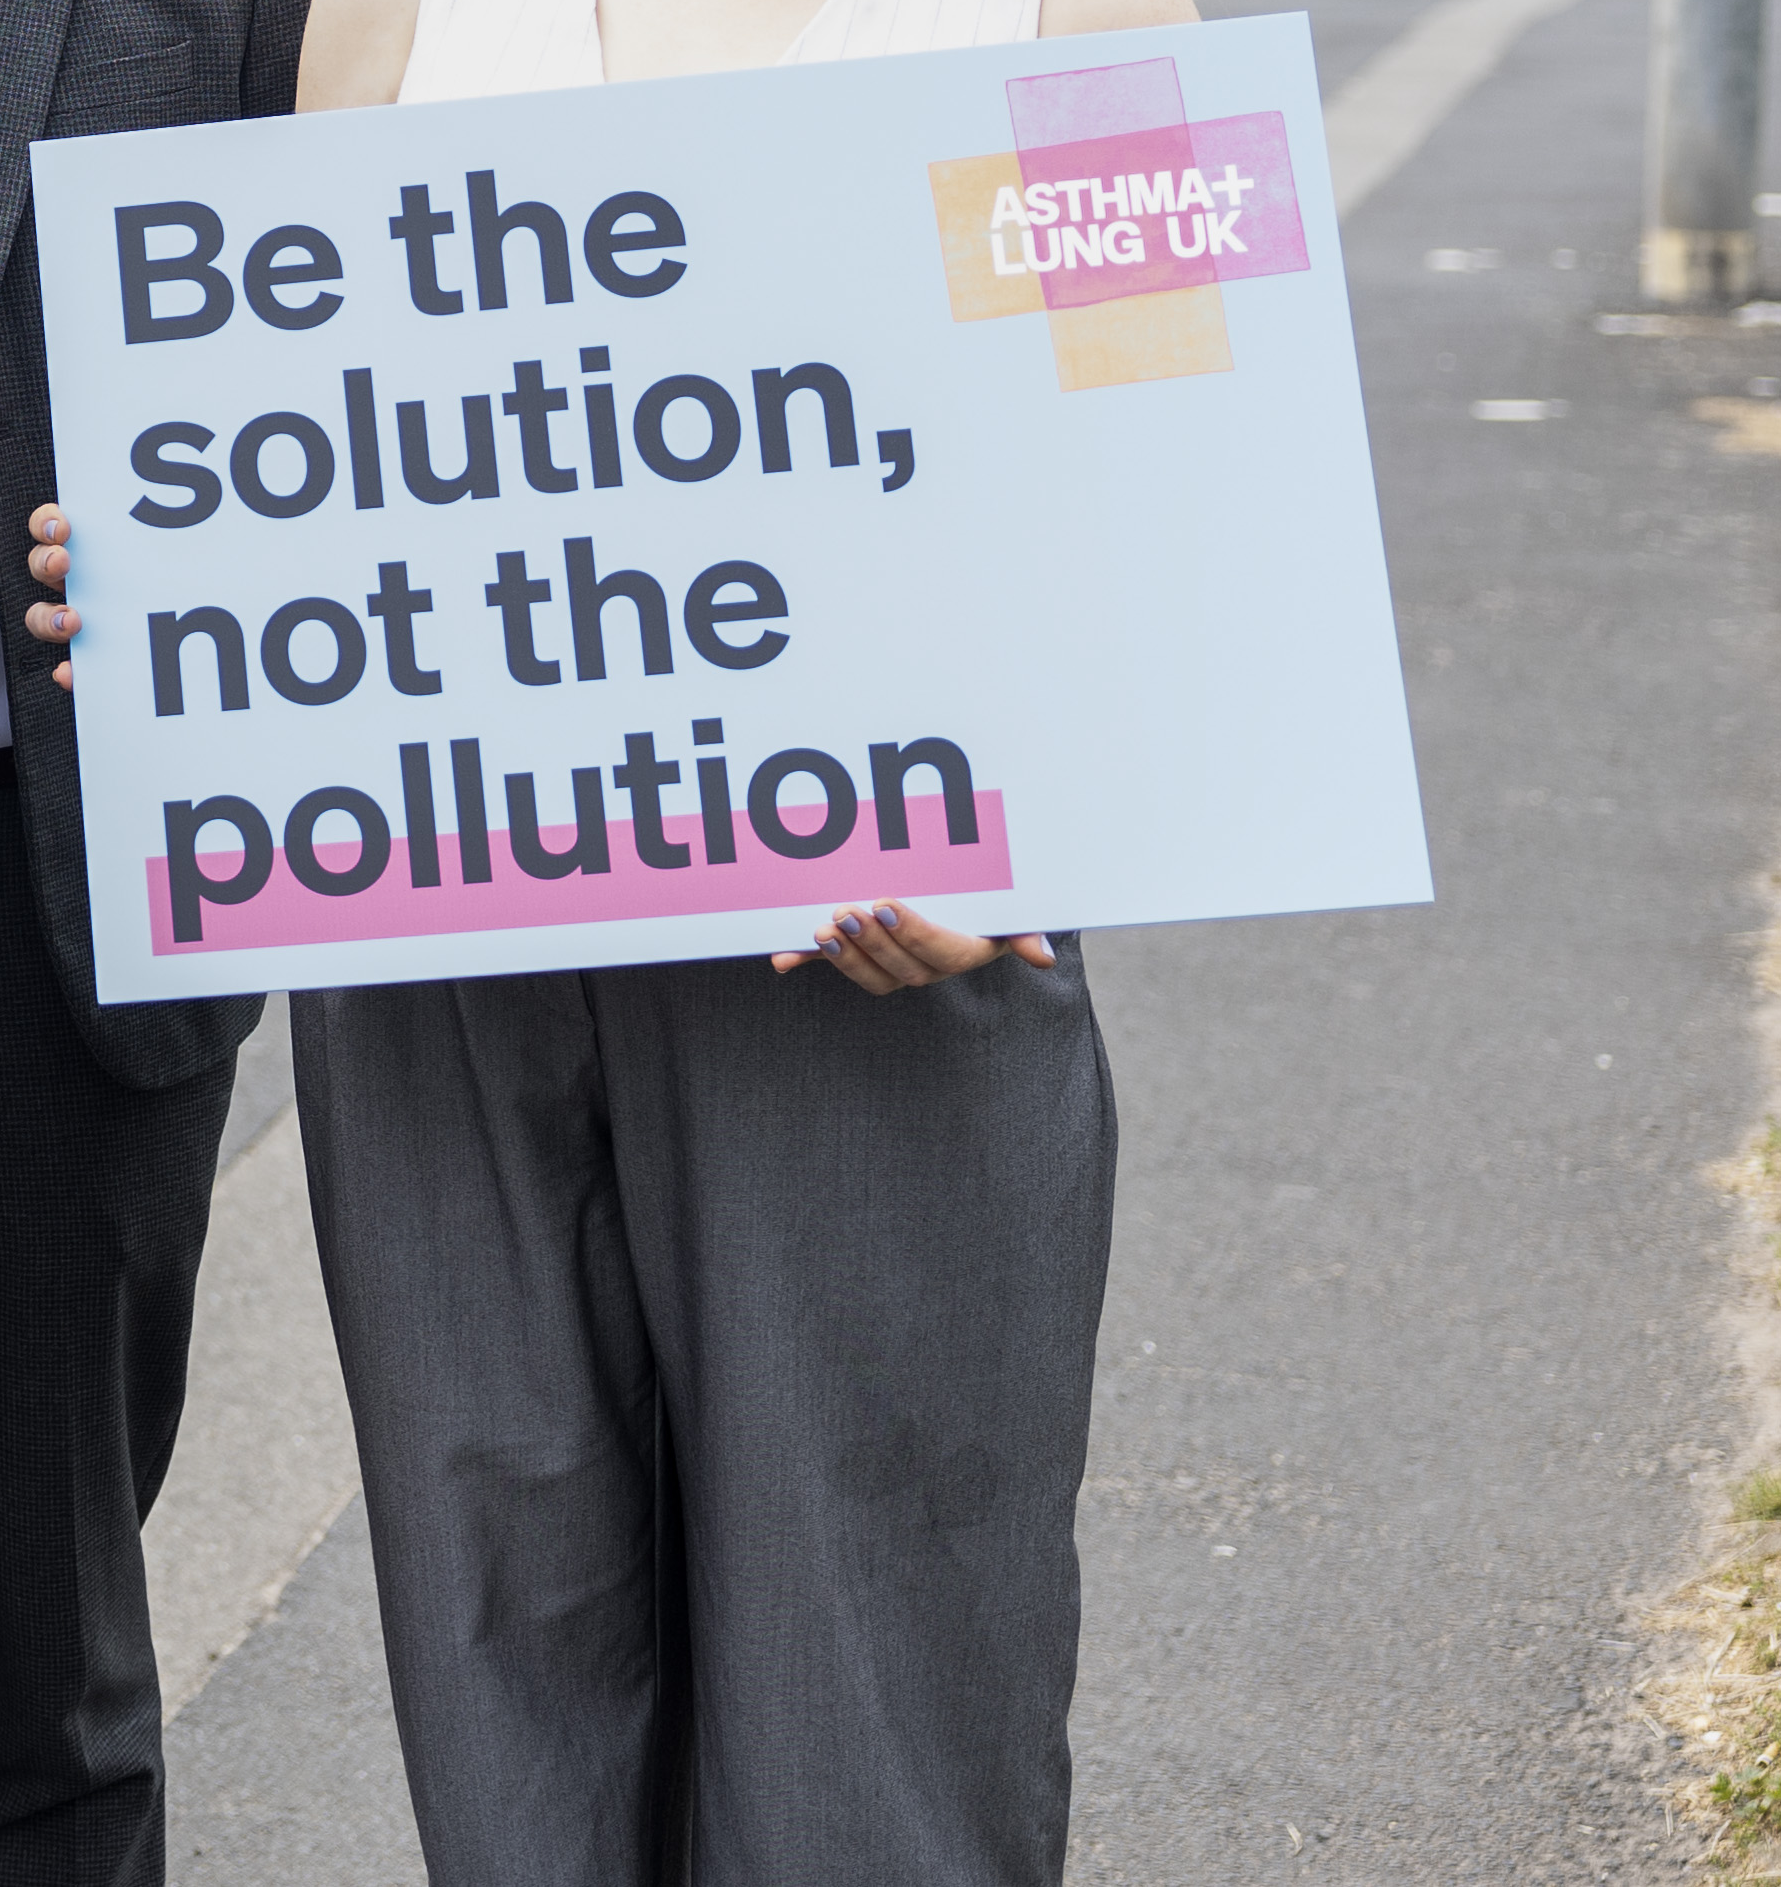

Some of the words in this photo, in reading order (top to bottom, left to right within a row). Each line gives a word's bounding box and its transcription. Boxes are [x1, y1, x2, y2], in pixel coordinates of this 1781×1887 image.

[113, 199, 345, 345] Be
[388, 169, 688, 316] the
[989, 221, 1146, 276] LUNG
[1166, 209, 1249, 260] UK
[125, 345, 915, 529] solution,
[147, 560, 443, 718] not
[484, 536, 790, 687] the
[162, 716, 980, 943] pollution
